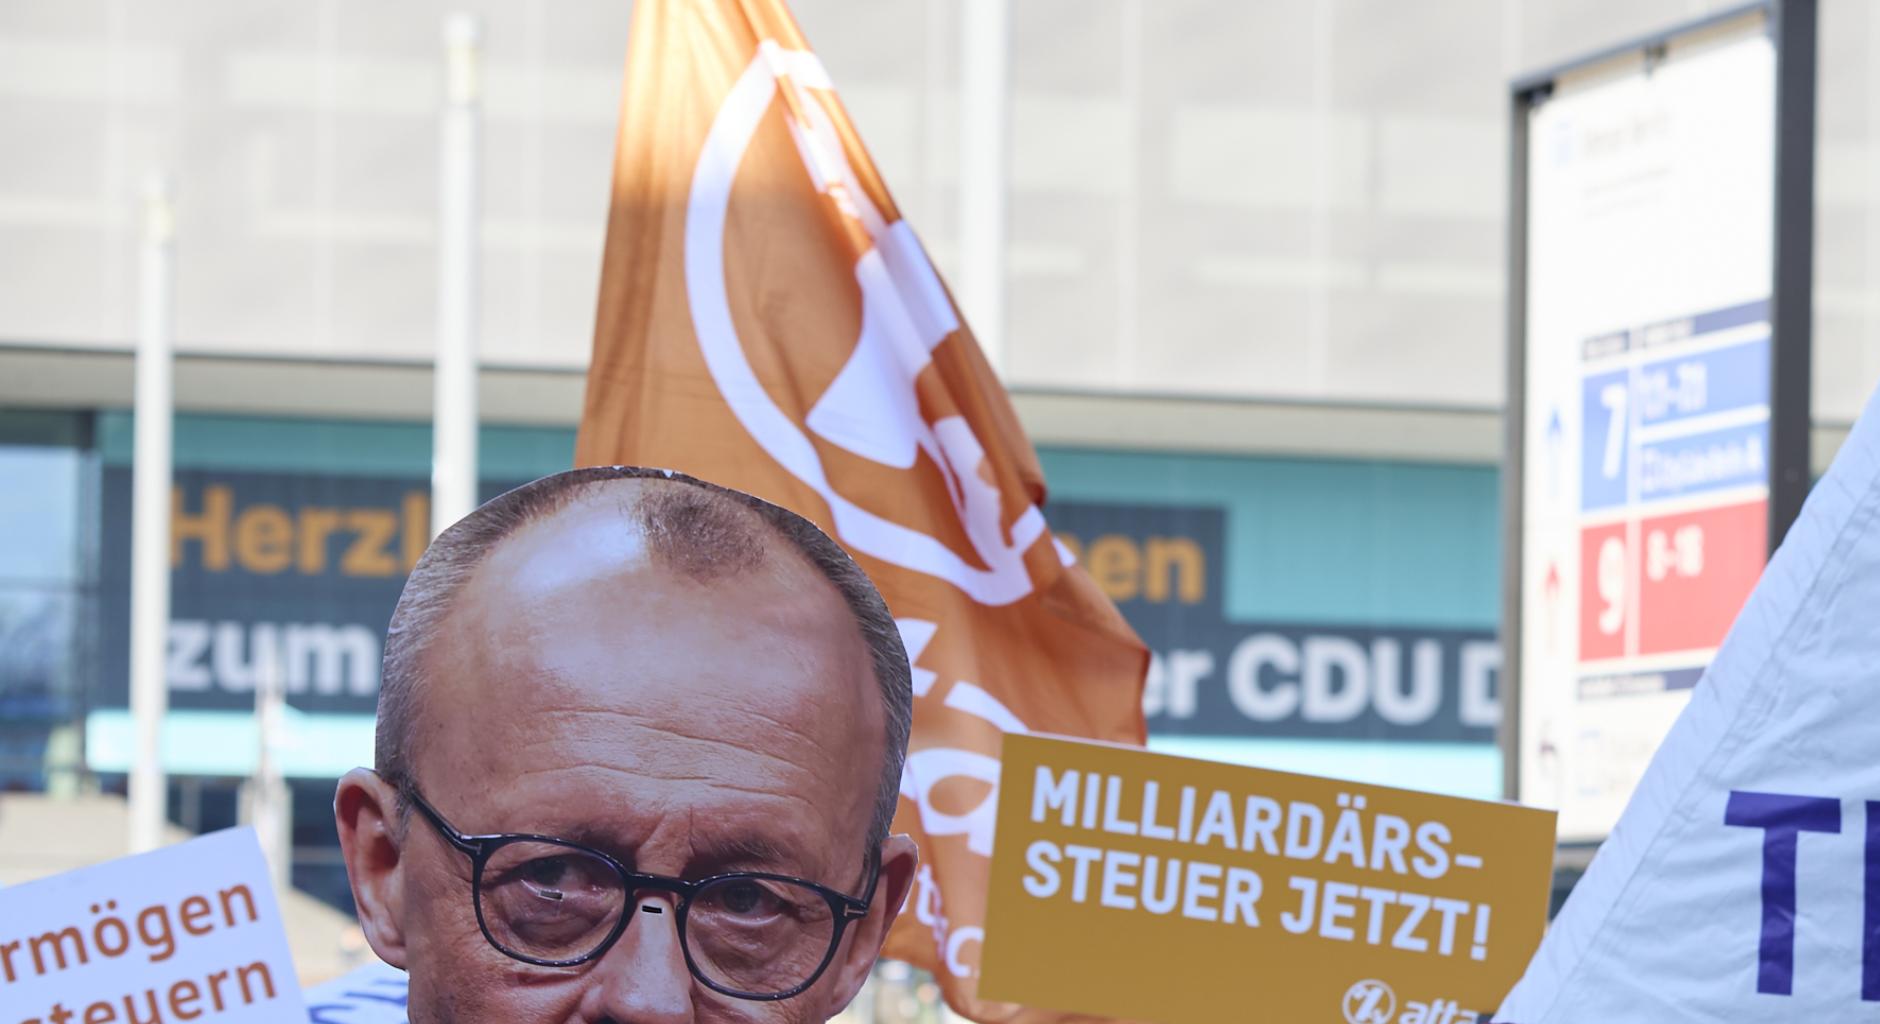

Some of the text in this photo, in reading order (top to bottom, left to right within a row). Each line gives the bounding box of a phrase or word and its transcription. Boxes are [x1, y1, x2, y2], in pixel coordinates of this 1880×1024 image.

[166, 620, 381, 697] zum
[1226, 632, 1443, 727] CDU
[1030, 764, 1484, 878] MILLIARDÄRS-
[1022, 840, 1264, 928] STEUER
[1279, 876, 1493, 961] JETZT!
